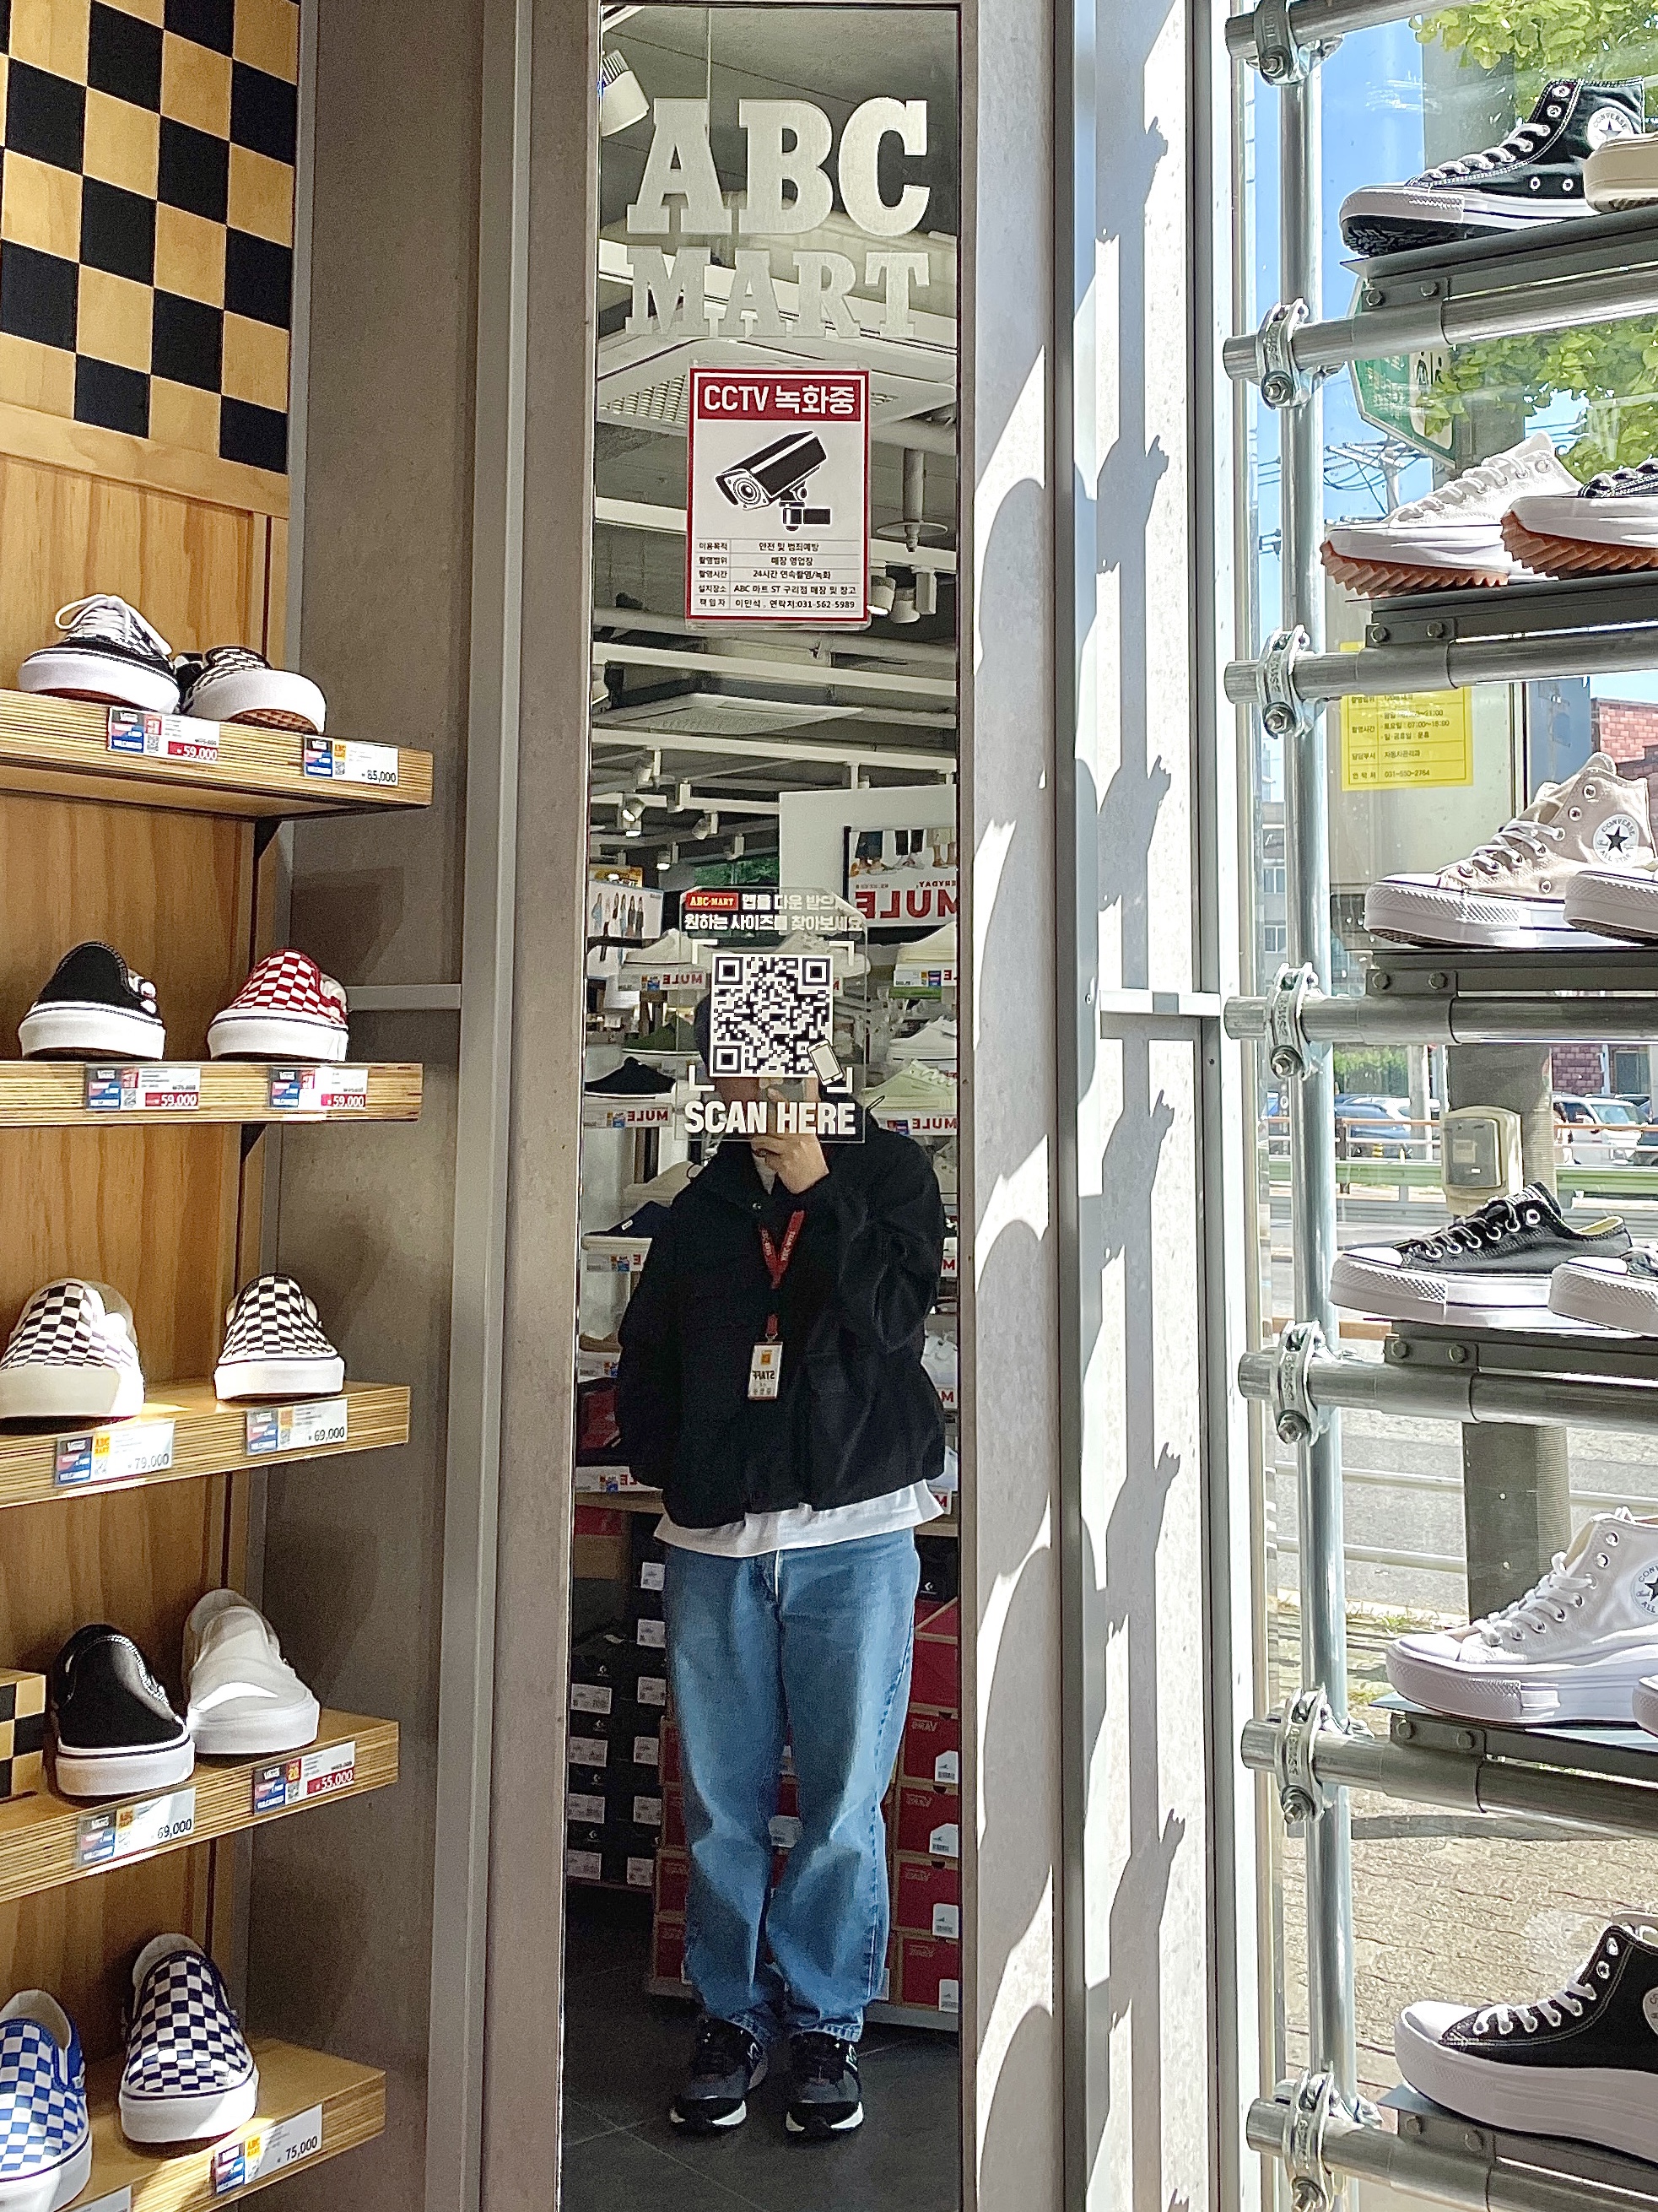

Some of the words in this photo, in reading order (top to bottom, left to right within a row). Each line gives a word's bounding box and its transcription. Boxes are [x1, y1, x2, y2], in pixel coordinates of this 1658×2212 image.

[626, 97, 930, 236] ABC
[625, 246, 930, 338] MART
[704, 385, 769, 411] CCTV
[775, 384, 856, 414] 녹화중
[753, 570, 778, 579] 24시간
[1601, 819, 1635, 836] CONVERSE
[689, 895, 734, 906] ABC-MART
[774, 894, 802, 910] 다운
[684, 914, 727, 930] 원하는
[791, 916, 863, 931] 찾아보세요
[160, 1094, 197, 1107] 59,000
[332, 1095, 365, 1107] 59,000
[684, 1101, 768, 1135] SCAN
[775, 1101, 856, 1135] HERE
[314, 1426, 345, 1442] 69,000
[1641, 1601, 1655, 1613] ALL
[157, 1819, 192, 1839] 69,000
[286, 2135, 318, 2161] 75,000
